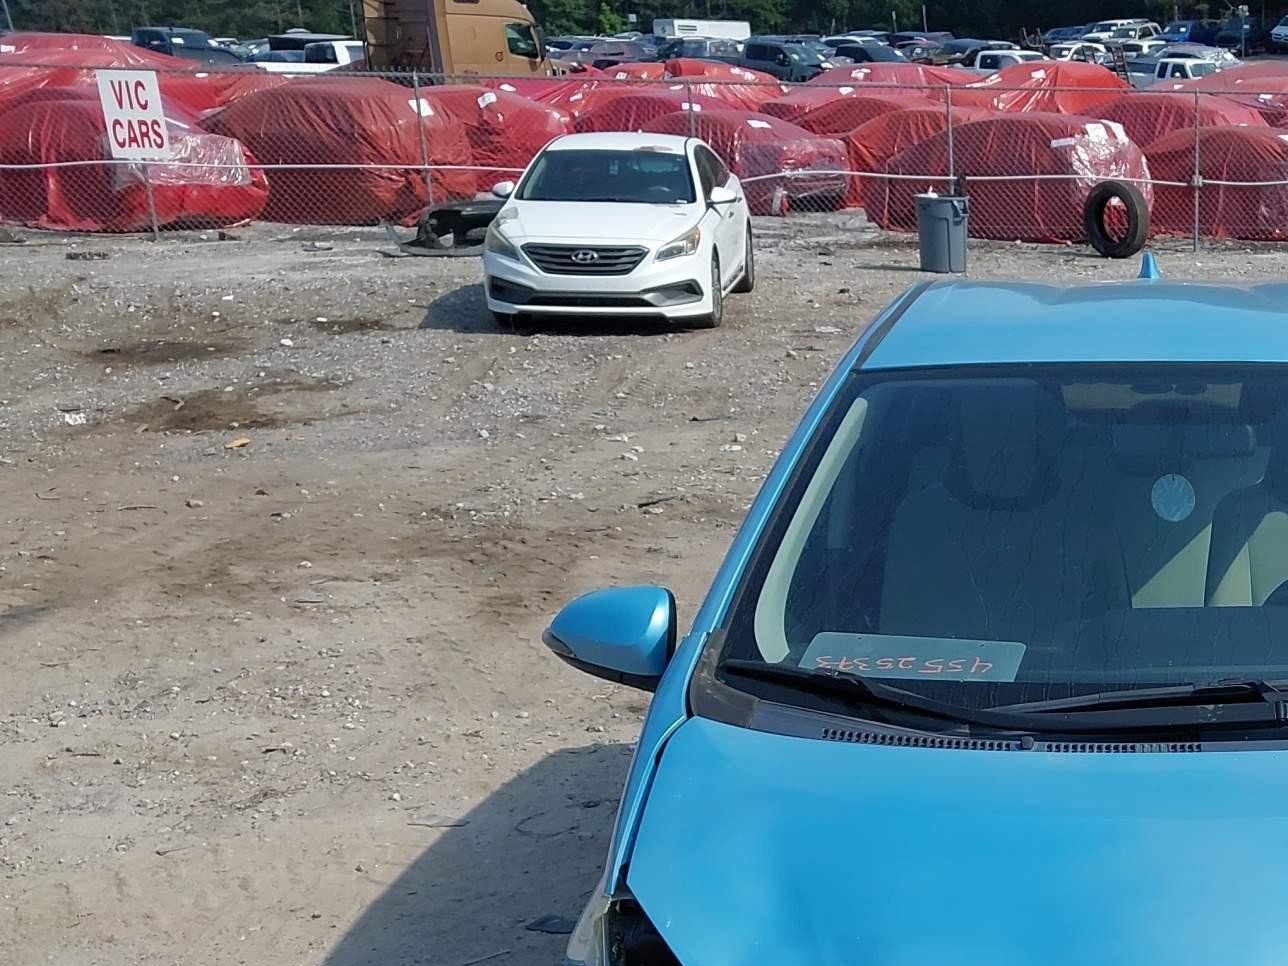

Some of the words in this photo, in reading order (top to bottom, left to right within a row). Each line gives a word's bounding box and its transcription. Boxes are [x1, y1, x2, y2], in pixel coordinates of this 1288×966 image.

[110, 80, 148, 110] VIC
[112, 118, 165, 149] CARS
[814, 655, 993, 673] 45525373
